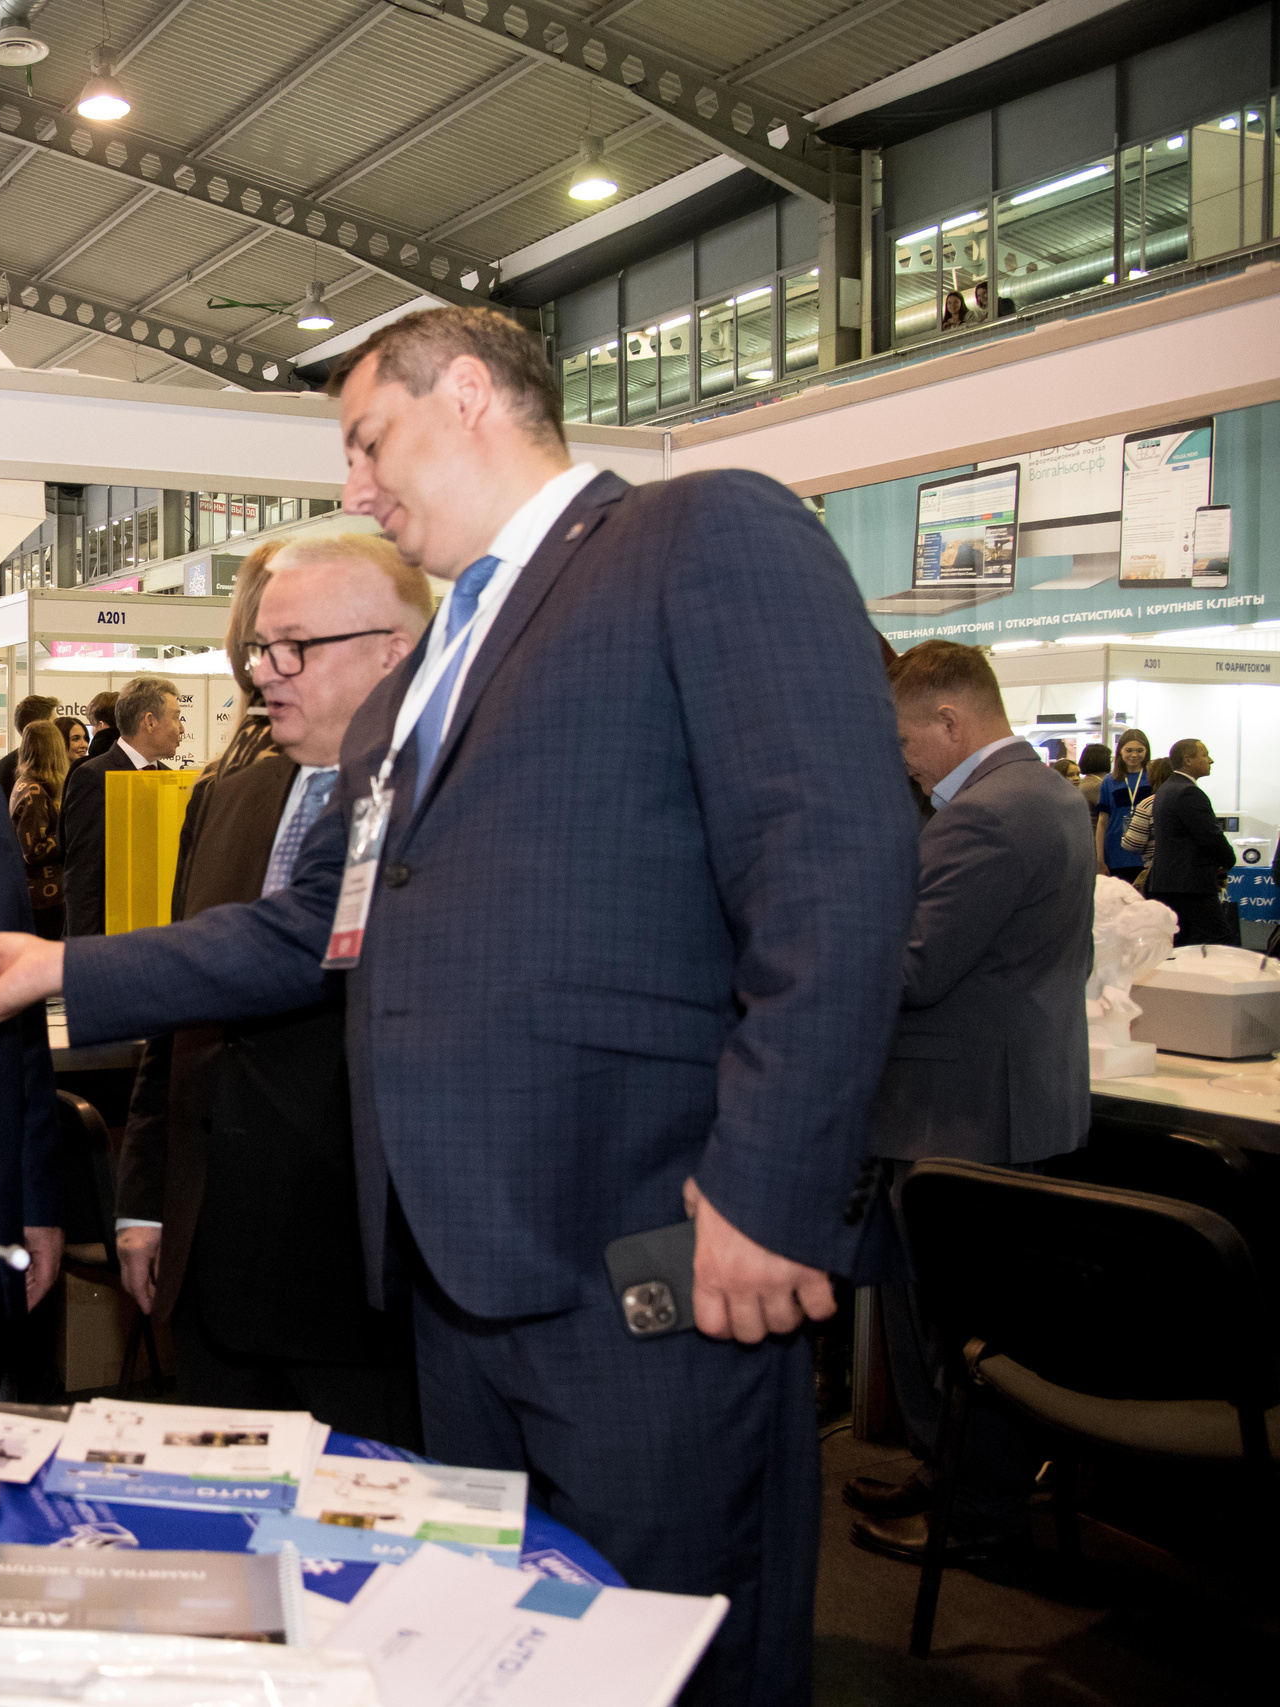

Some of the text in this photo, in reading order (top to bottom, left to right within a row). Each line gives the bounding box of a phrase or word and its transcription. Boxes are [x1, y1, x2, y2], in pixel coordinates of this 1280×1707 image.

[1082, 445, 1107, 455] портал
[1028, 453, 1107, 482] ВолгаНьюс.рф
[231, 505, 256, 517] ВЫОД
[97, 611, 126, 625] A201
[936, 621, 995, 637] АУДИТОРИЯ
[1005, 614, 1060, 629] ОТКРЫТАЯ
[1061, 607, 1133, 625] СТАТИСТИКА
[1146, 600, 1204, 616] КРУПНЫЕ
[1215, 661, 1224, 672] ГК
[55, 701, 88, 717] ente
[1227, 875, 1244, 884] DW
[1249, 897, 1276, 907] VDW
[75, 1566, 106, 1578] ПО
[109, 1567, 207, 1582] ПАМЯТКА
